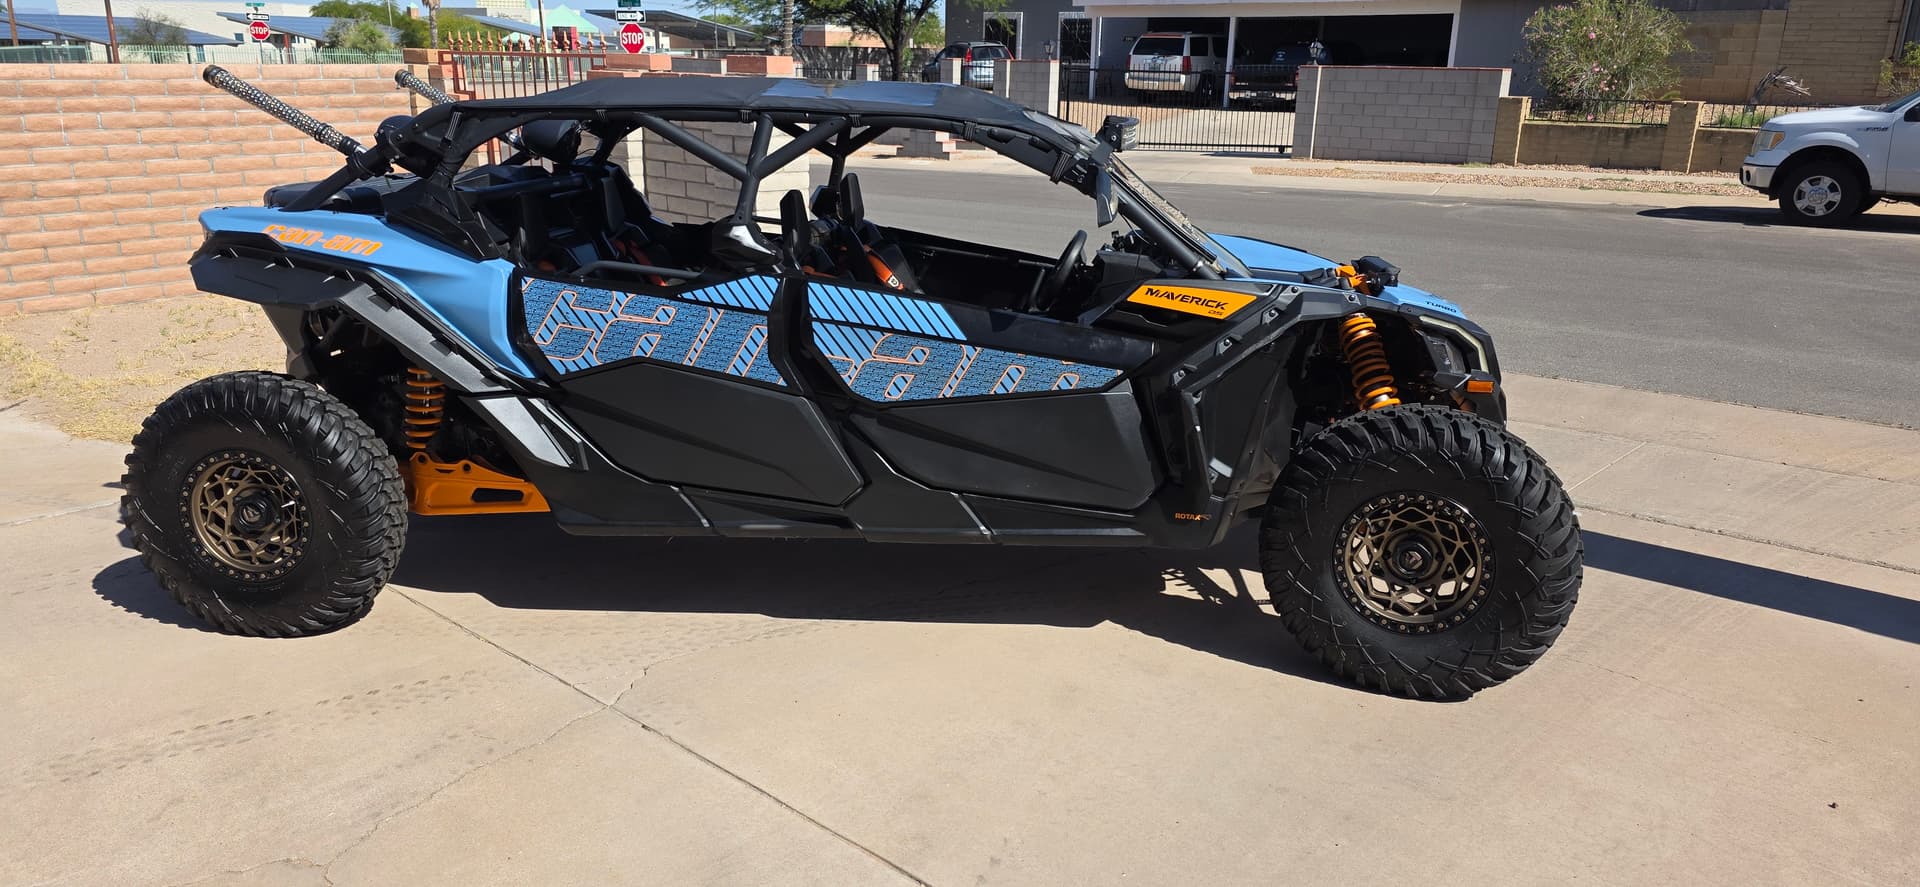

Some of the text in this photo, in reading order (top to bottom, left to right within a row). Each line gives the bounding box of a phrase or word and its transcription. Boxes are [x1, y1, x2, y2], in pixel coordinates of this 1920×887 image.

[251, 26, 268, 35] STOP
[622, 32, 643, 45] STOP
[1145, 286, 1229, 311] MAVERICK
[1425, 300, 1457, 313] TURBO
